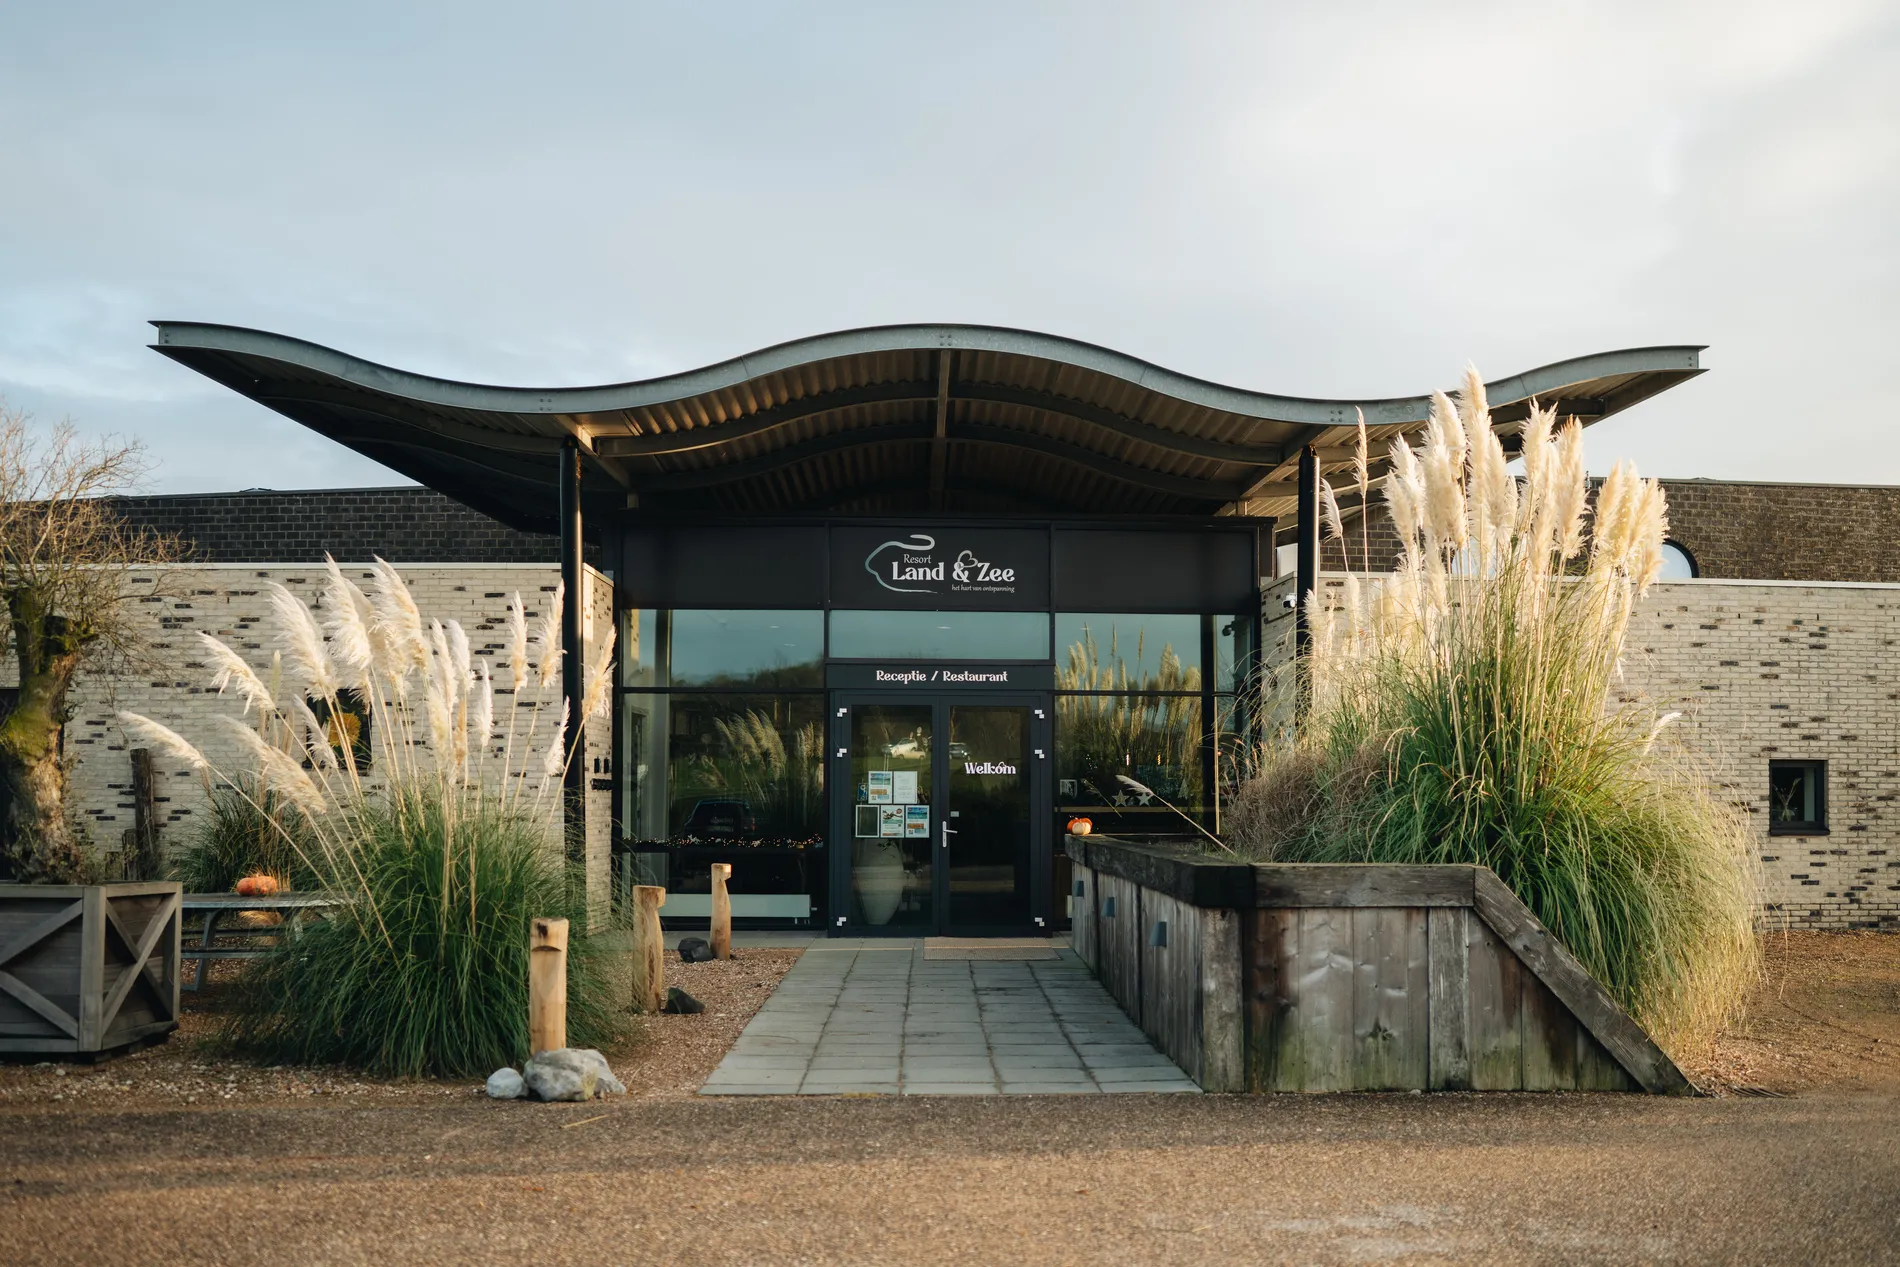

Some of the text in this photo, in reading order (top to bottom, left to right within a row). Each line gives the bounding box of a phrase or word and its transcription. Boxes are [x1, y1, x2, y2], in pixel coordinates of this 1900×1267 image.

[903, 554, 931, 564] Resort
[892, 561, 1015, 582] Land & Zee
[982, 585, 1015, 593] ontspanning
[876, 670, 1008, 684] Receptie / Restaurant
[964, 761, 1016, 774] Welkom
